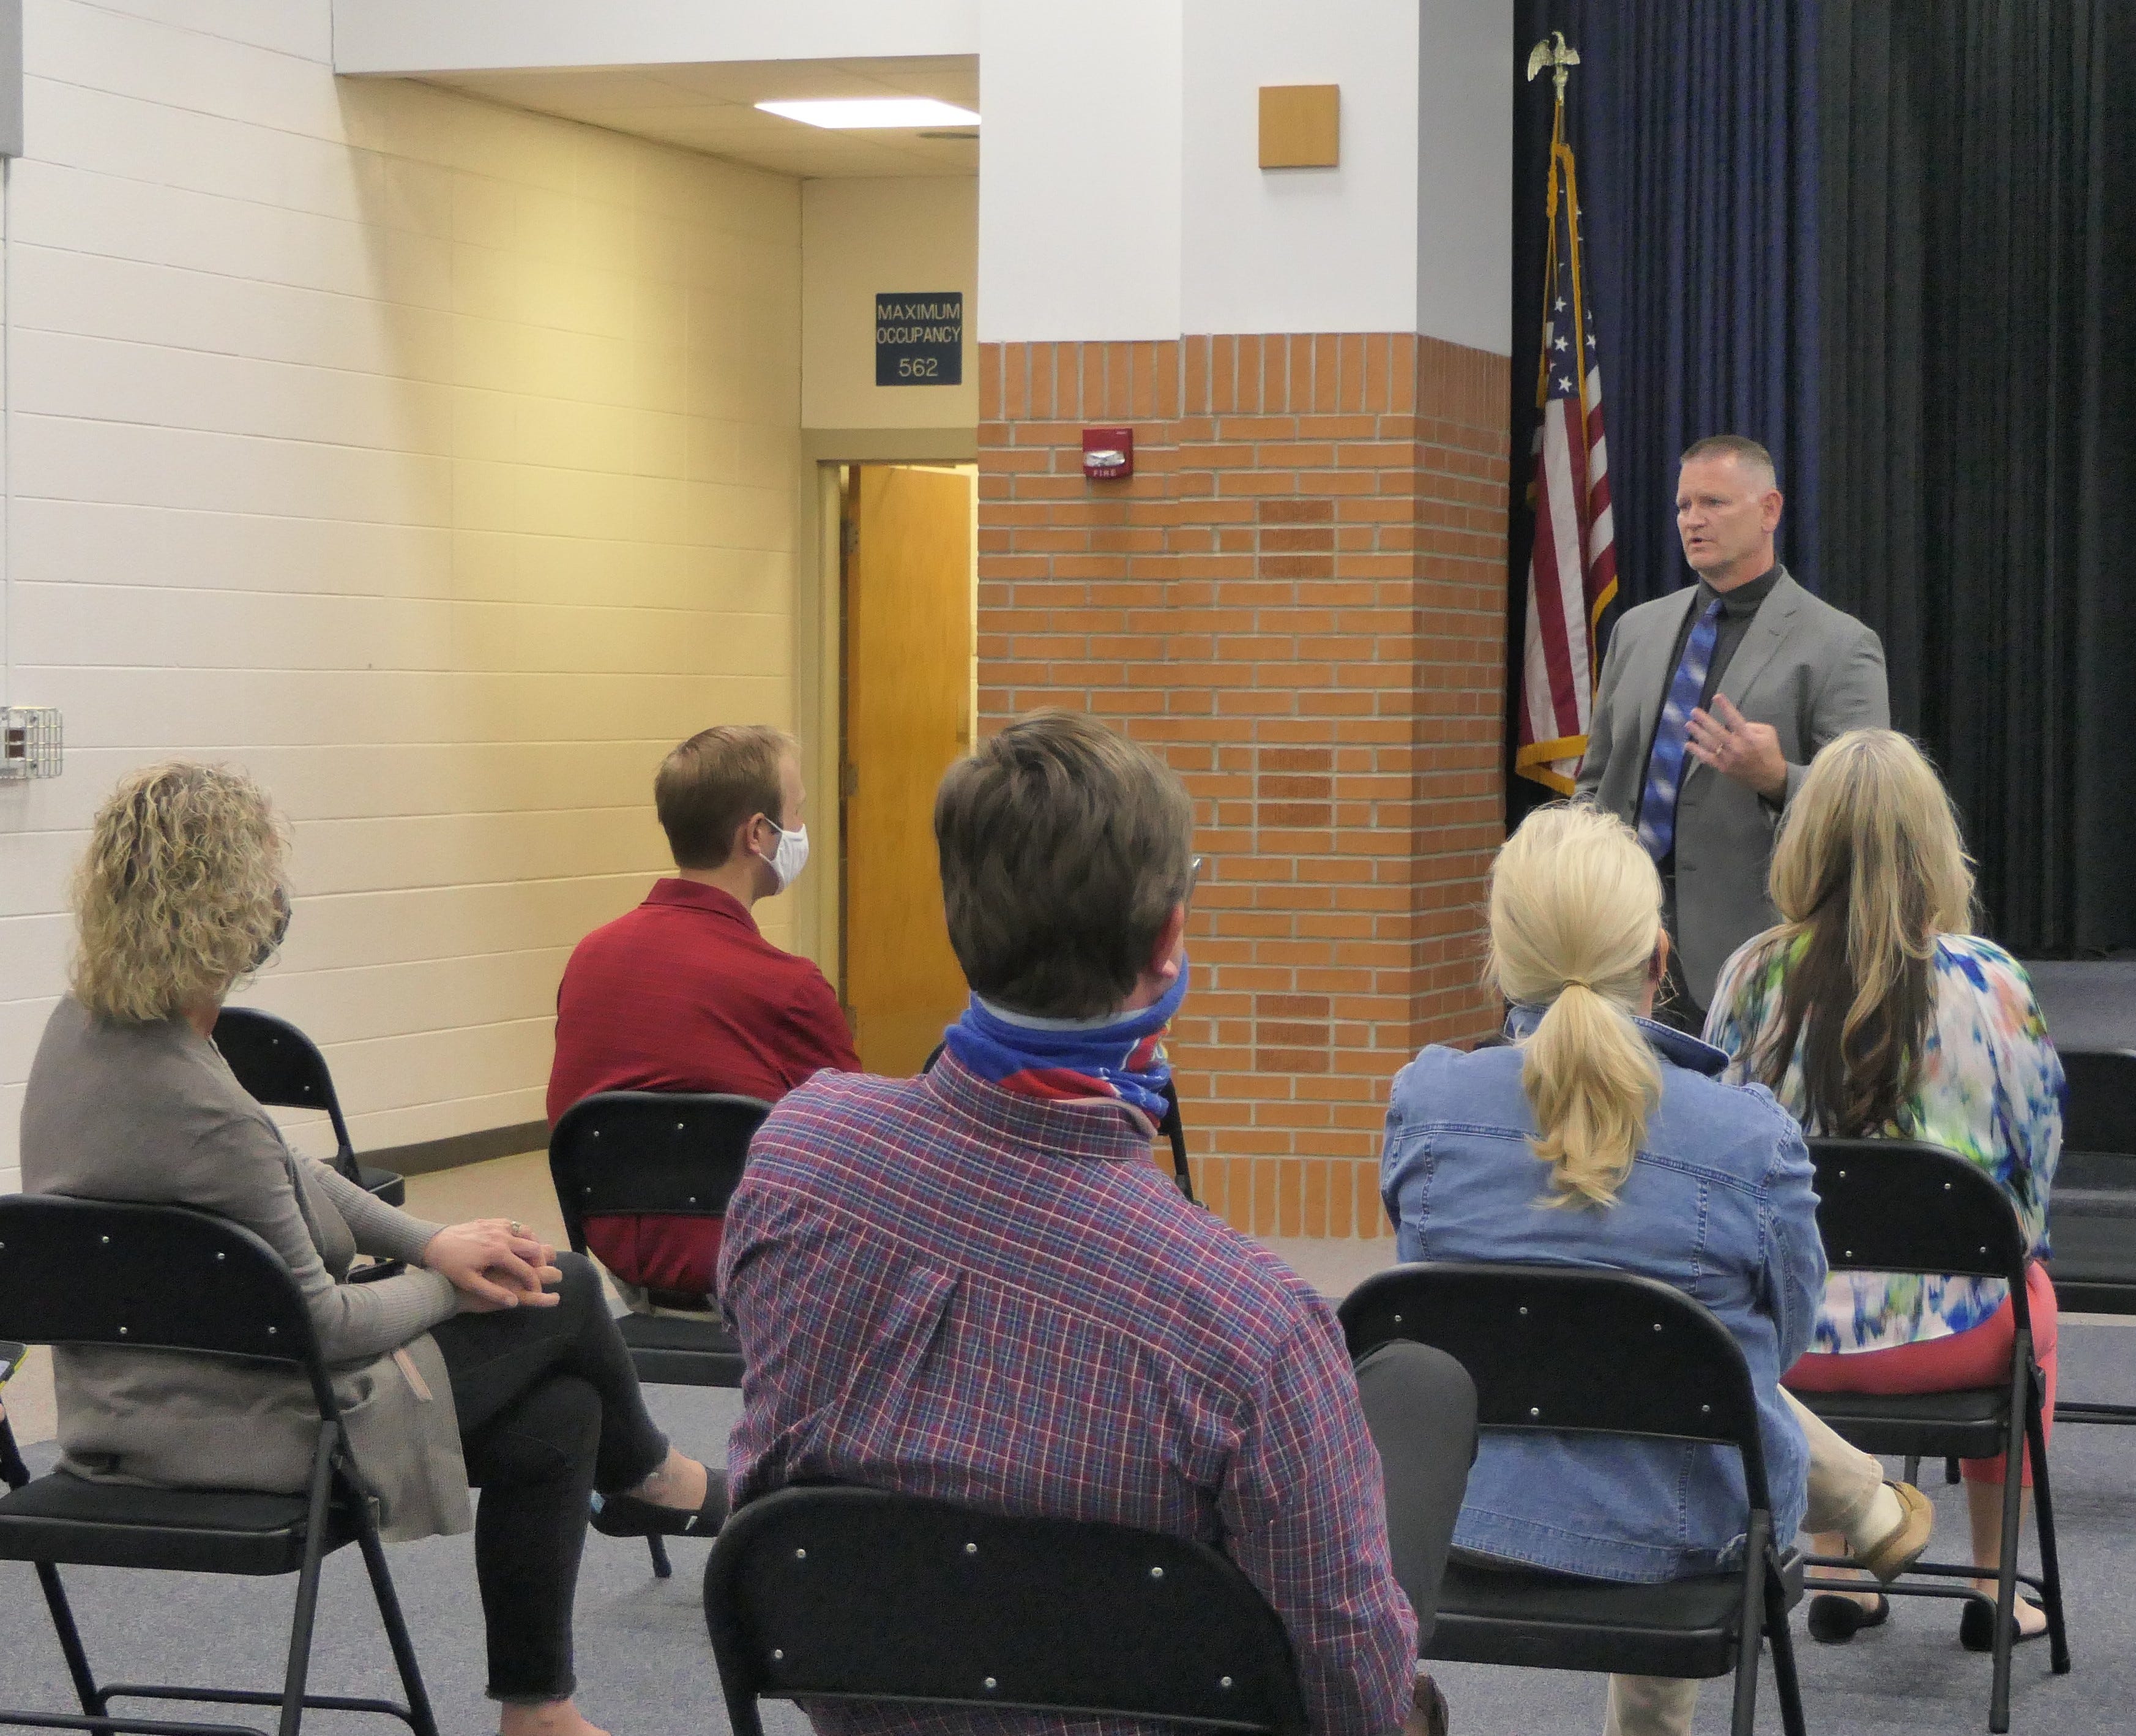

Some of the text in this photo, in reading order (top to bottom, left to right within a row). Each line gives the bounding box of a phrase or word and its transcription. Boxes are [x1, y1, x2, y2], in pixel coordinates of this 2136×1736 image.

[878, 303, 960, 320] MAXIMUM
[877, 326, 961, 344] OCCUPANCY
[899, 358, 938, 377] 562
